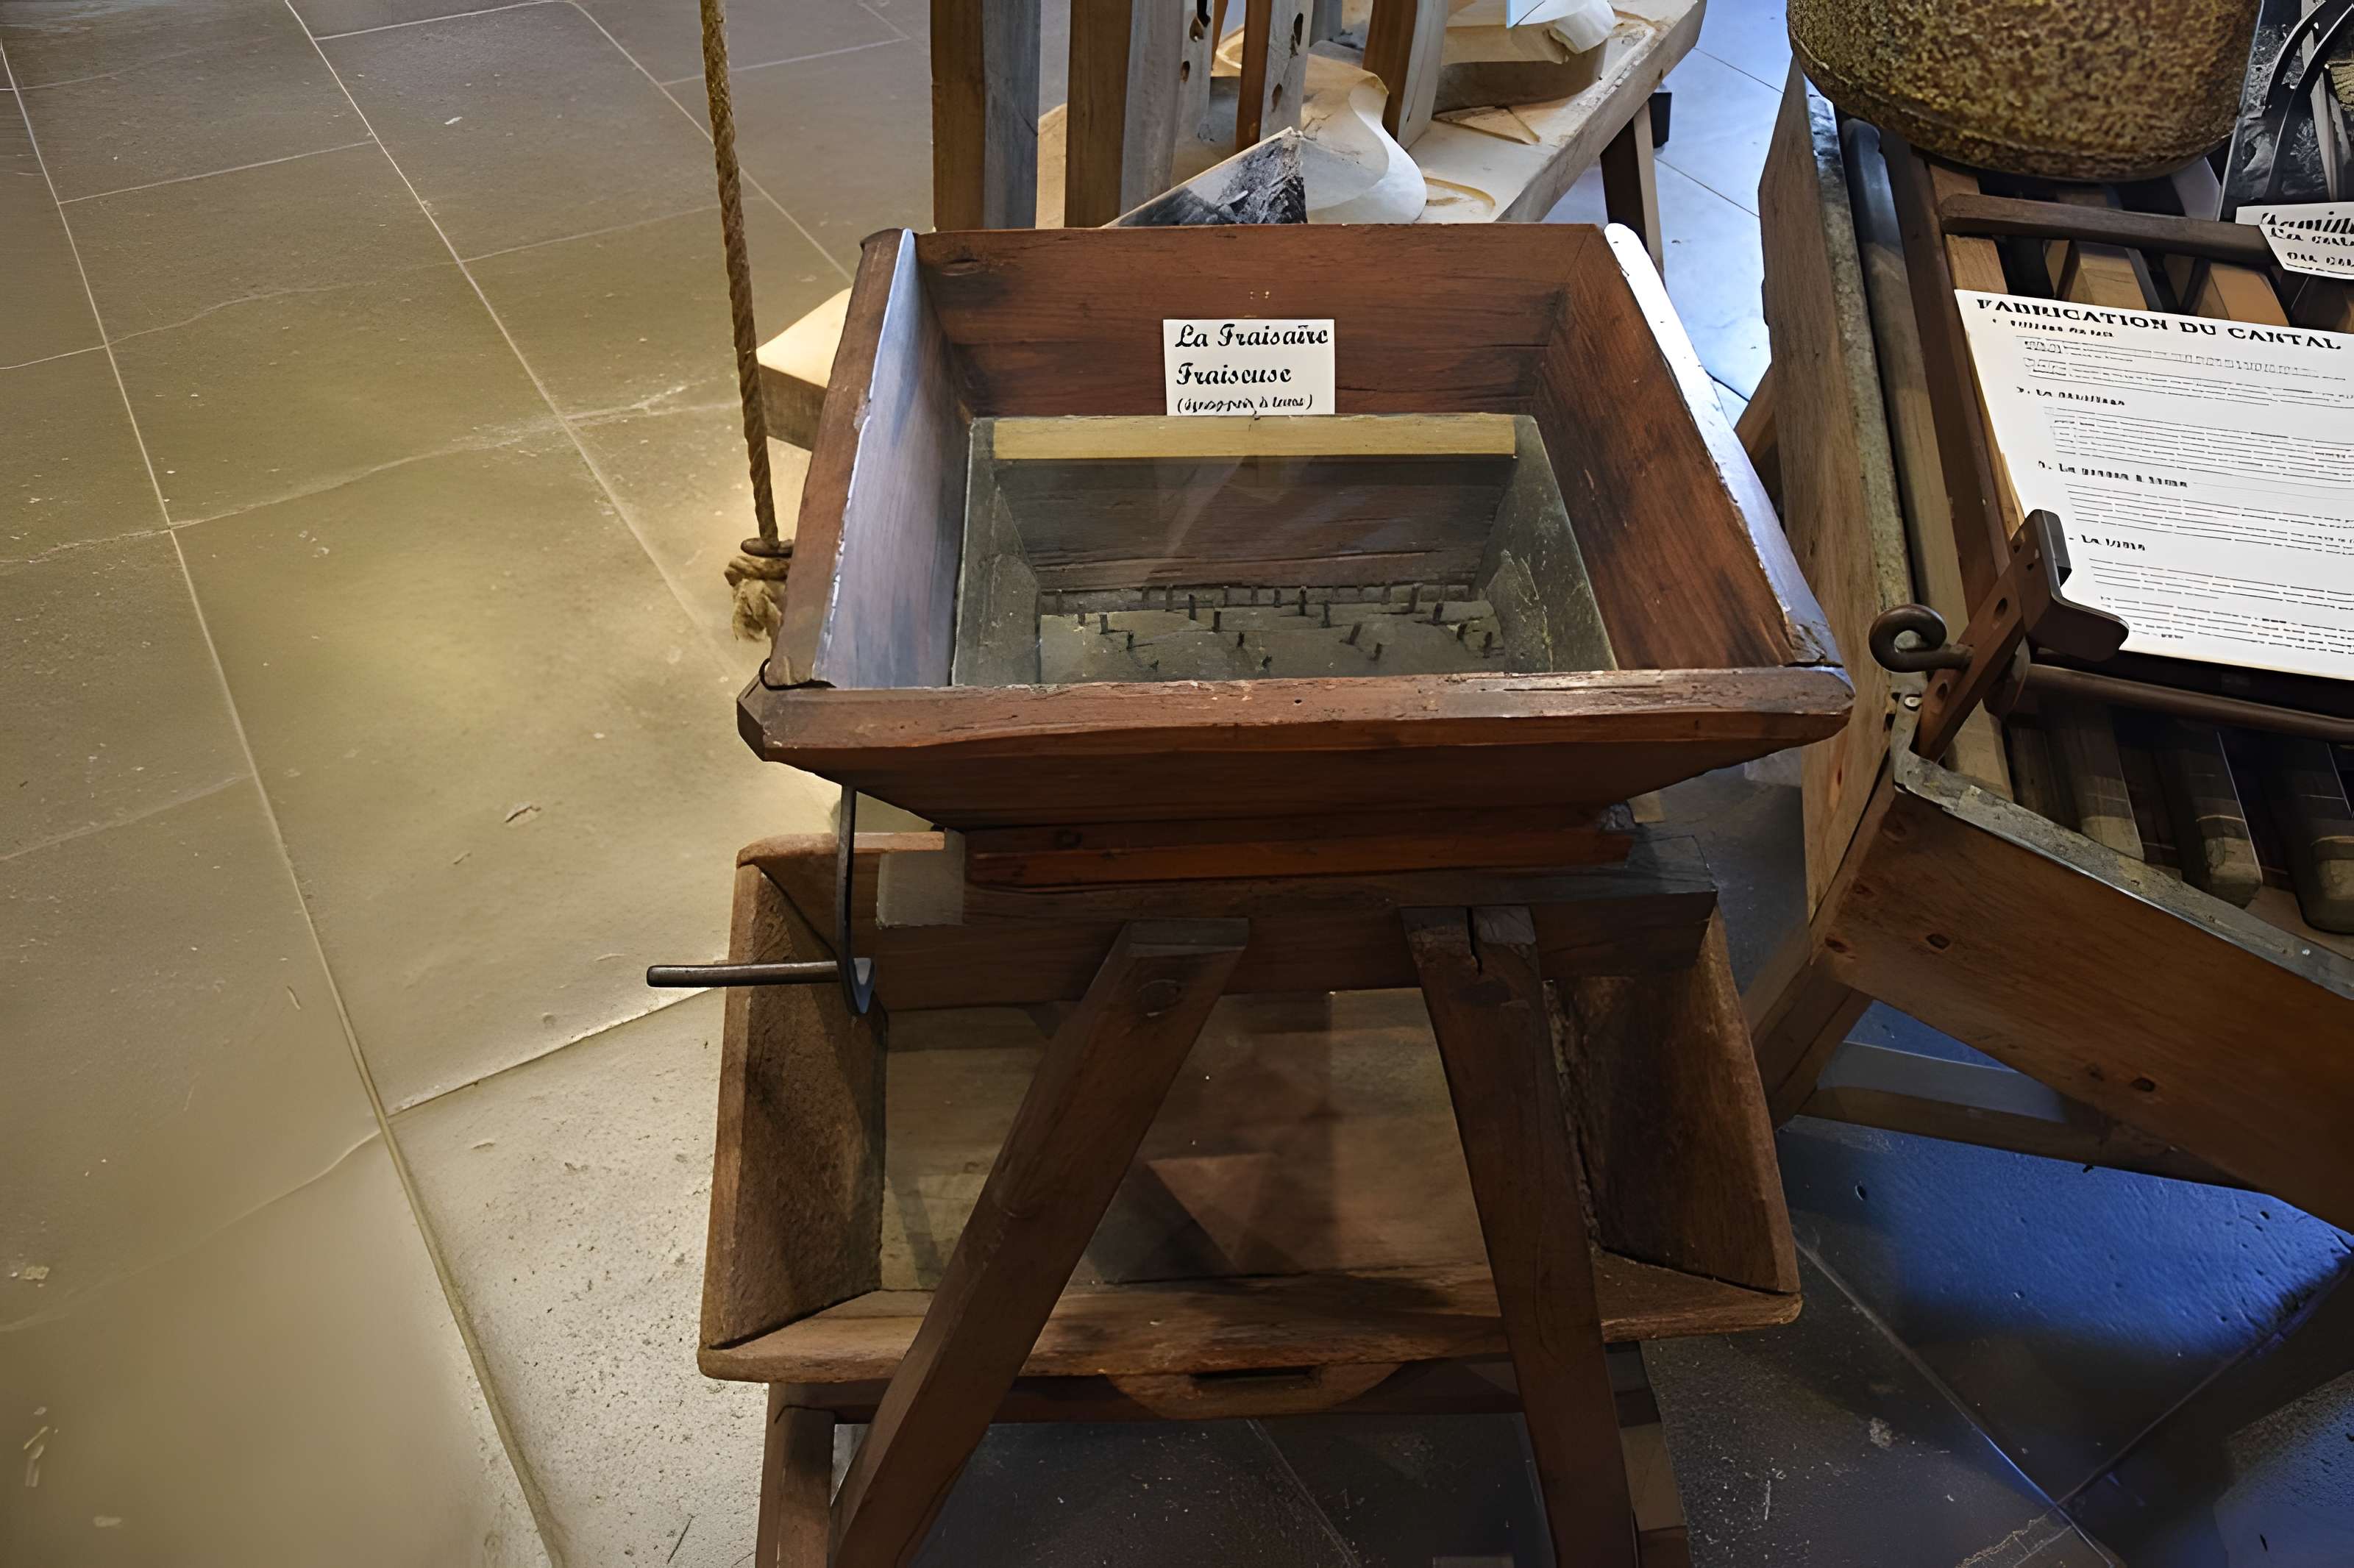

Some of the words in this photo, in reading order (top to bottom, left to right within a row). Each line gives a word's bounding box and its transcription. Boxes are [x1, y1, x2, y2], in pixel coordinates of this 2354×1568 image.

[1175, 324, 1209, 348] La
[1976, 298, 2169, 330] FABRICATION
[2178, 321, 2216, 335] DU
[2227, 327, 2341, 350] CANTAL
[1176, 362, 1292, 385] Fraiseuse
